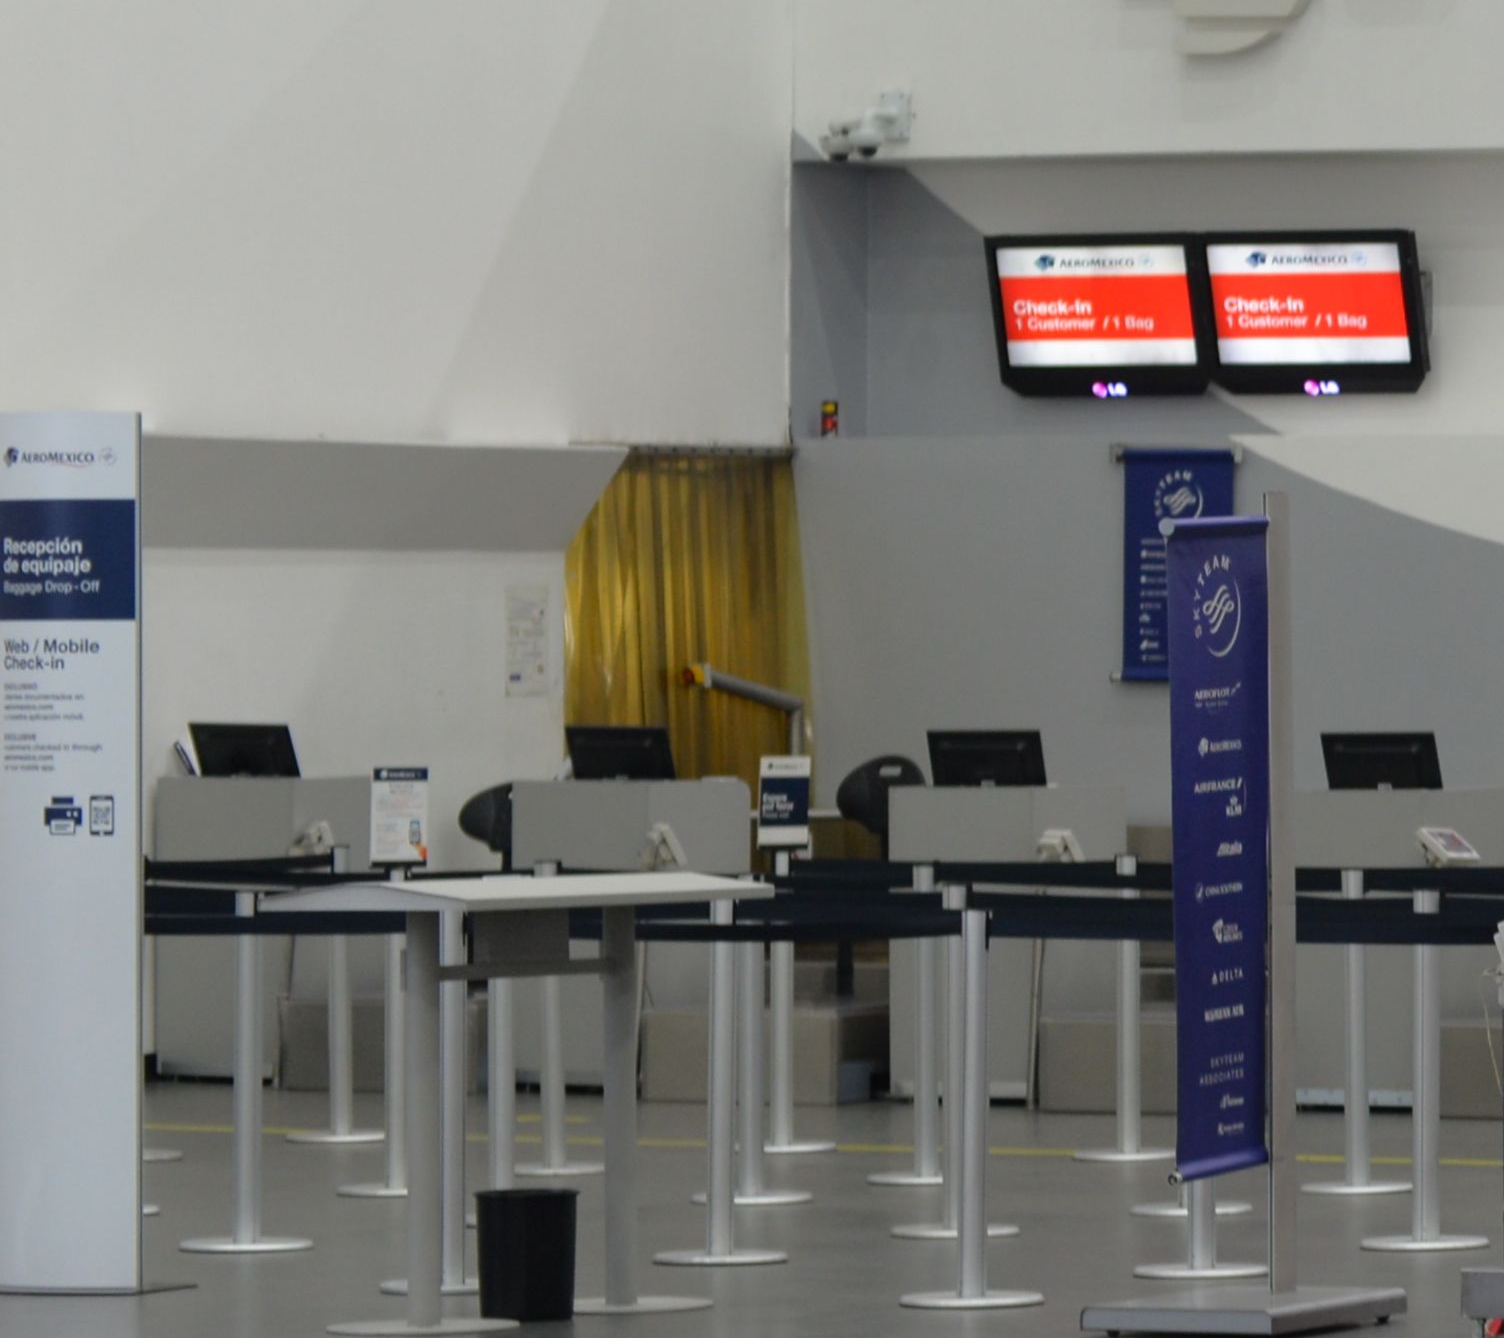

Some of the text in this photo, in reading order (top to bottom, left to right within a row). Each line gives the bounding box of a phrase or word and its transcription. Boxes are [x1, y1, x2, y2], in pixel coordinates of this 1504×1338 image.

[1014, 300, 1092, 315] Check-In
[1224, 296, 1304, 312] Check-In
[1016, 316, 1154, 332] 1 Customer / 1 Bag
[1227, 313, 1367, 329] 1 Customer / 1 Bag
[1109, 383, 1127, 396] LG
[1321, 381, 1339, 394] LG
[21, 452, 95, 464] AEROMEXICO
[3, 537, 83, 557] Recepción
[3, 557, 92, 577] de equipaje
[3, 580, 42, 595] Baggage
[4, 638, 100, 654] Web / Mobile
[4, 655, 65, 670] Check-in
